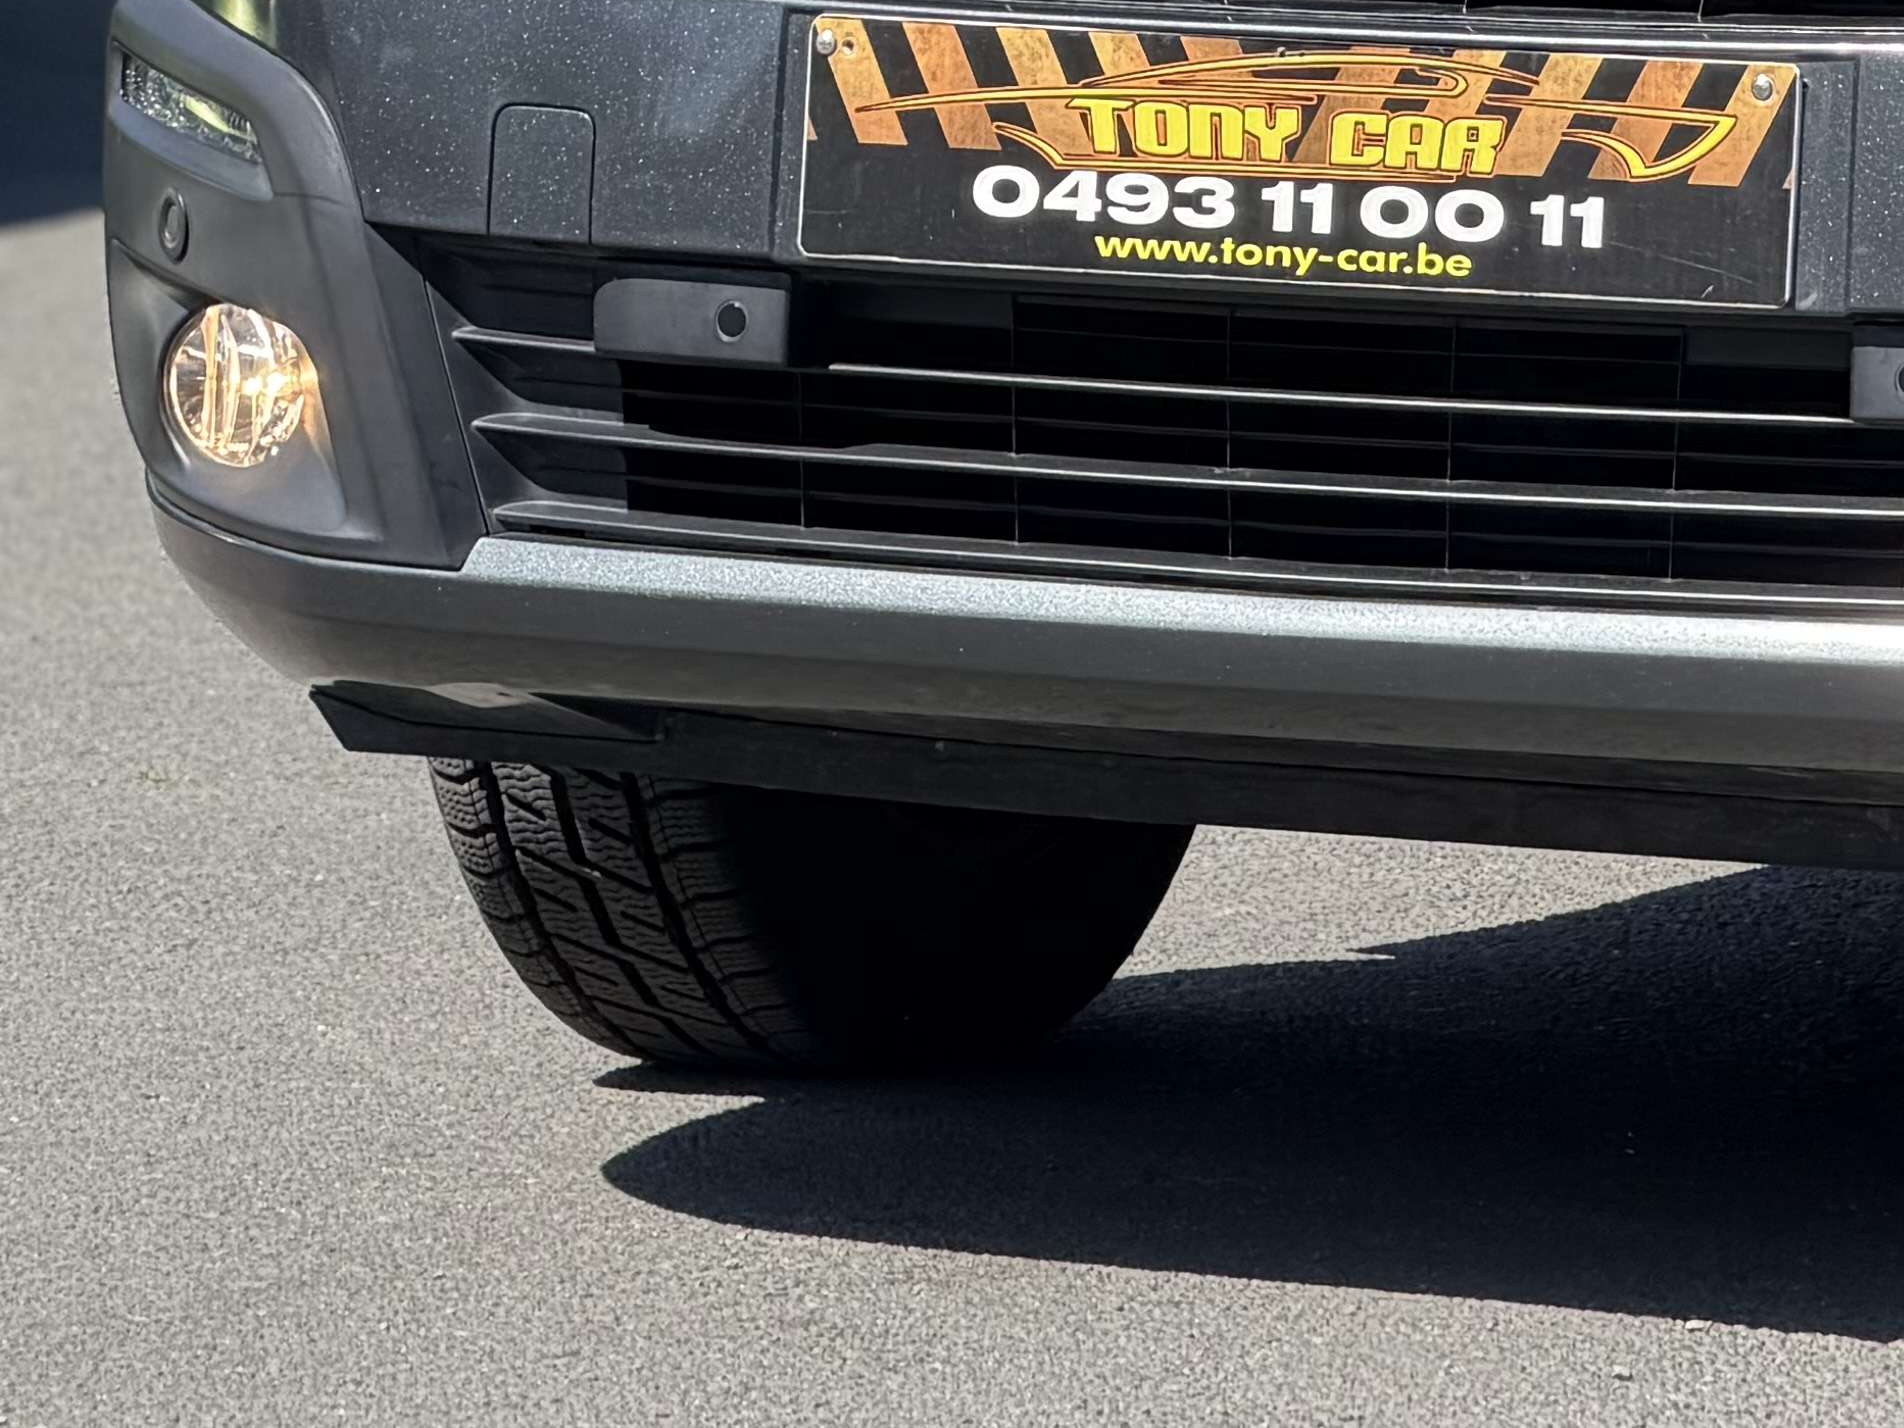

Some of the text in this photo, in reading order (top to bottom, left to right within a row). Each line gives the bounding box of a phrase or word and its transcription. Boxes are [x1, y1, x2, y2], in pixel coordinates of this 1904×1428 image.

[1066, 97, 1504, 175] TONY CAR
[973, 164, 1605, 249] 0493 11 00 11
[1094, 235, 1473, 277] www.tony-car.be
